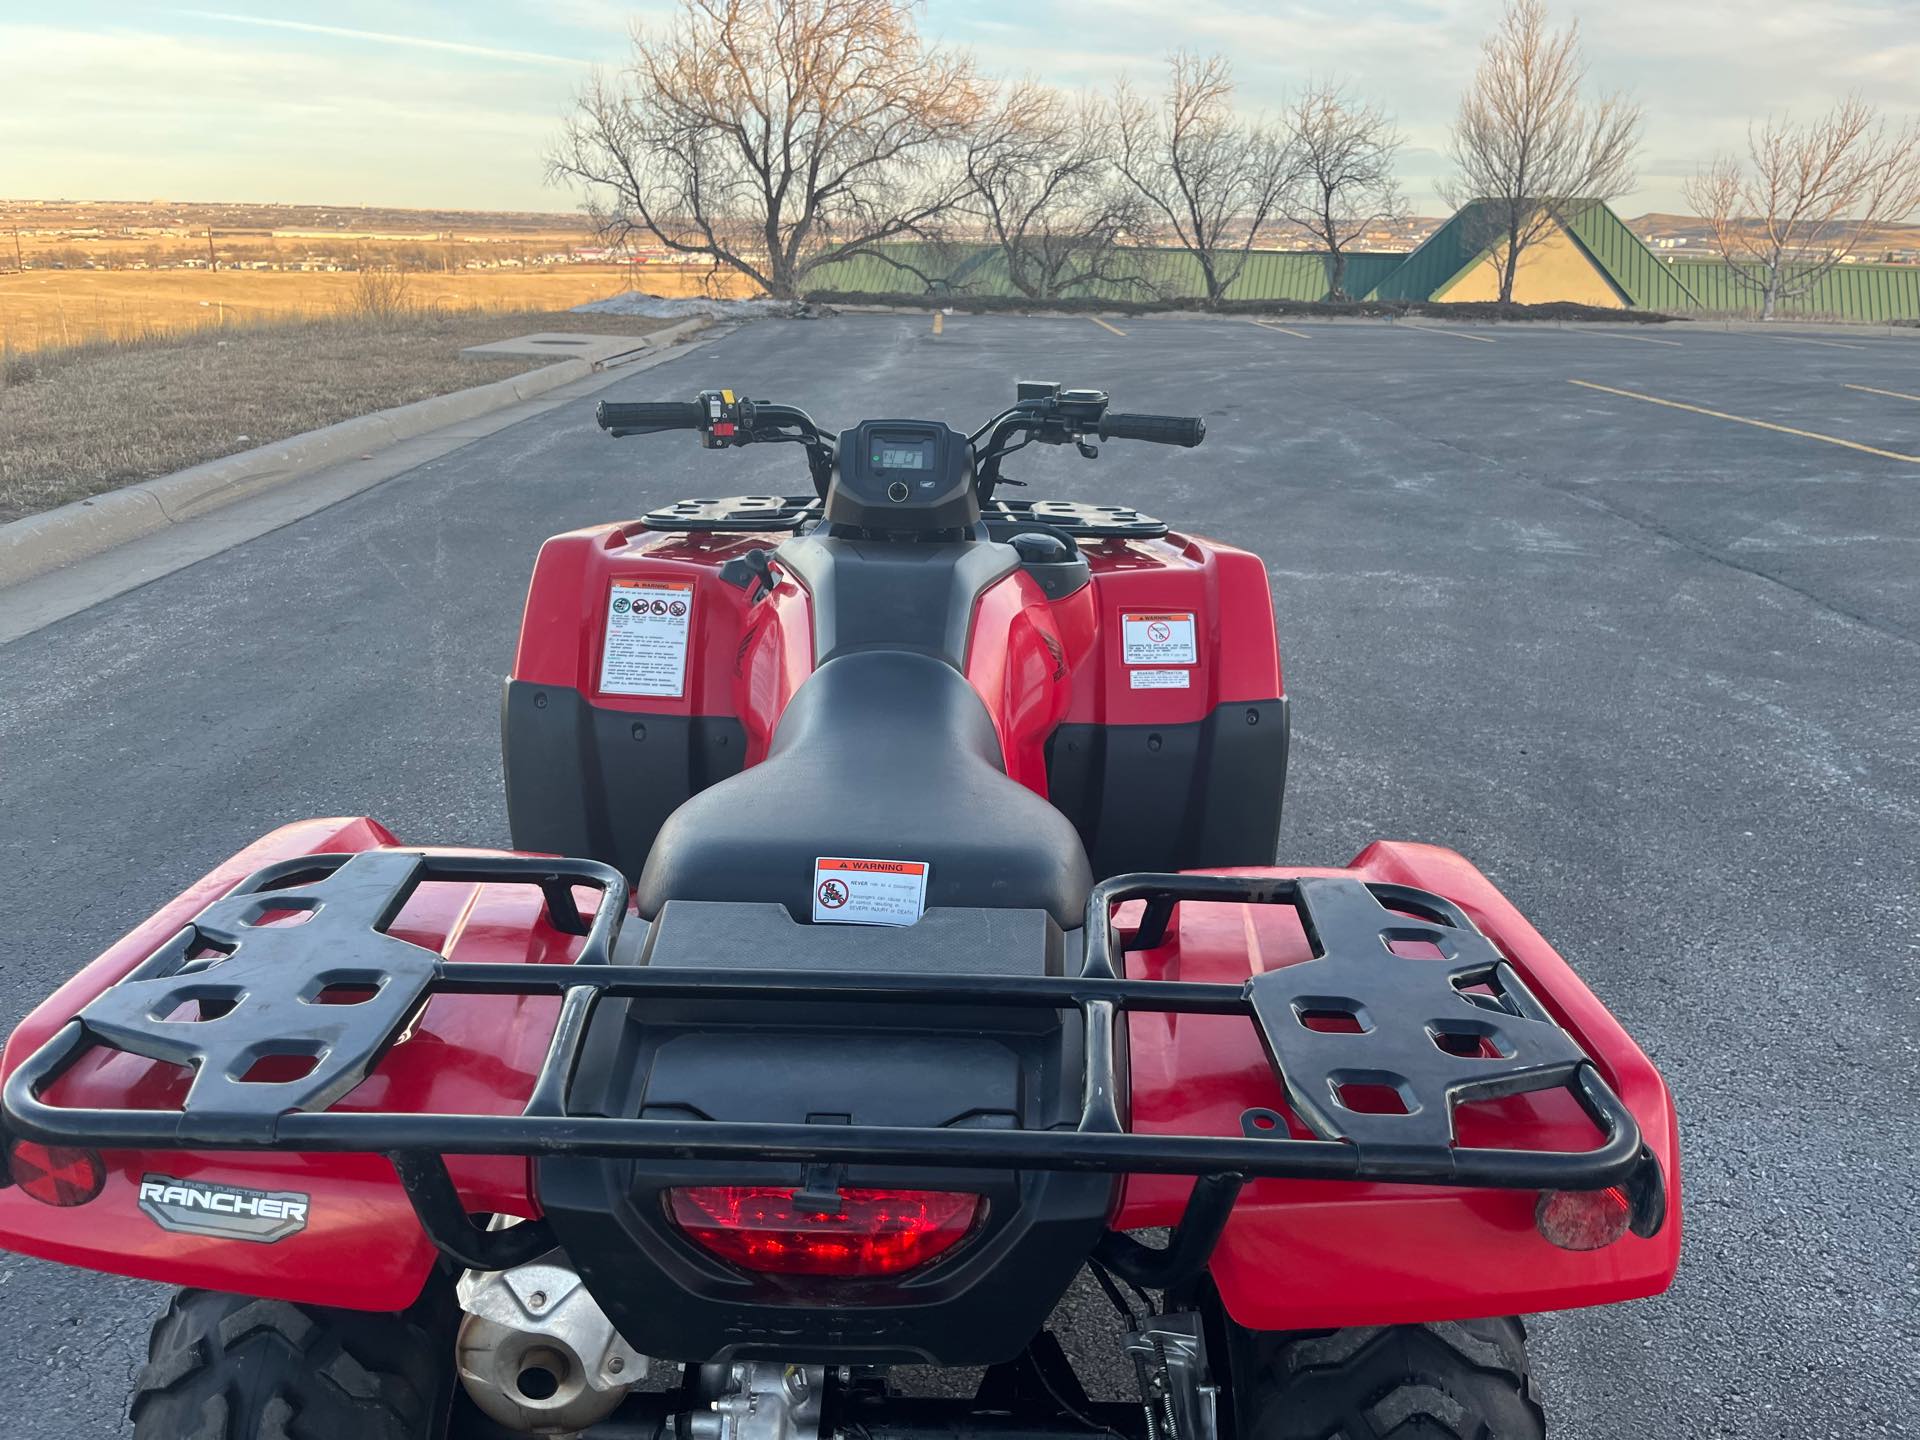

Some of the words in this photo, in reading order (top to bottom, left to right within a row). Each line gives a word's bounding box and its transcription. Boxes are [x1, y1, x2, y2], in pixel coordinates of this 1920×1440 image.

[853, 863, 902, 871] WARNING
[184, 1181, 212, 1190] FUEL
[213, 1185, 266, 1198] INJECTION
[139, 1182, 308, 1222] RANCHER
